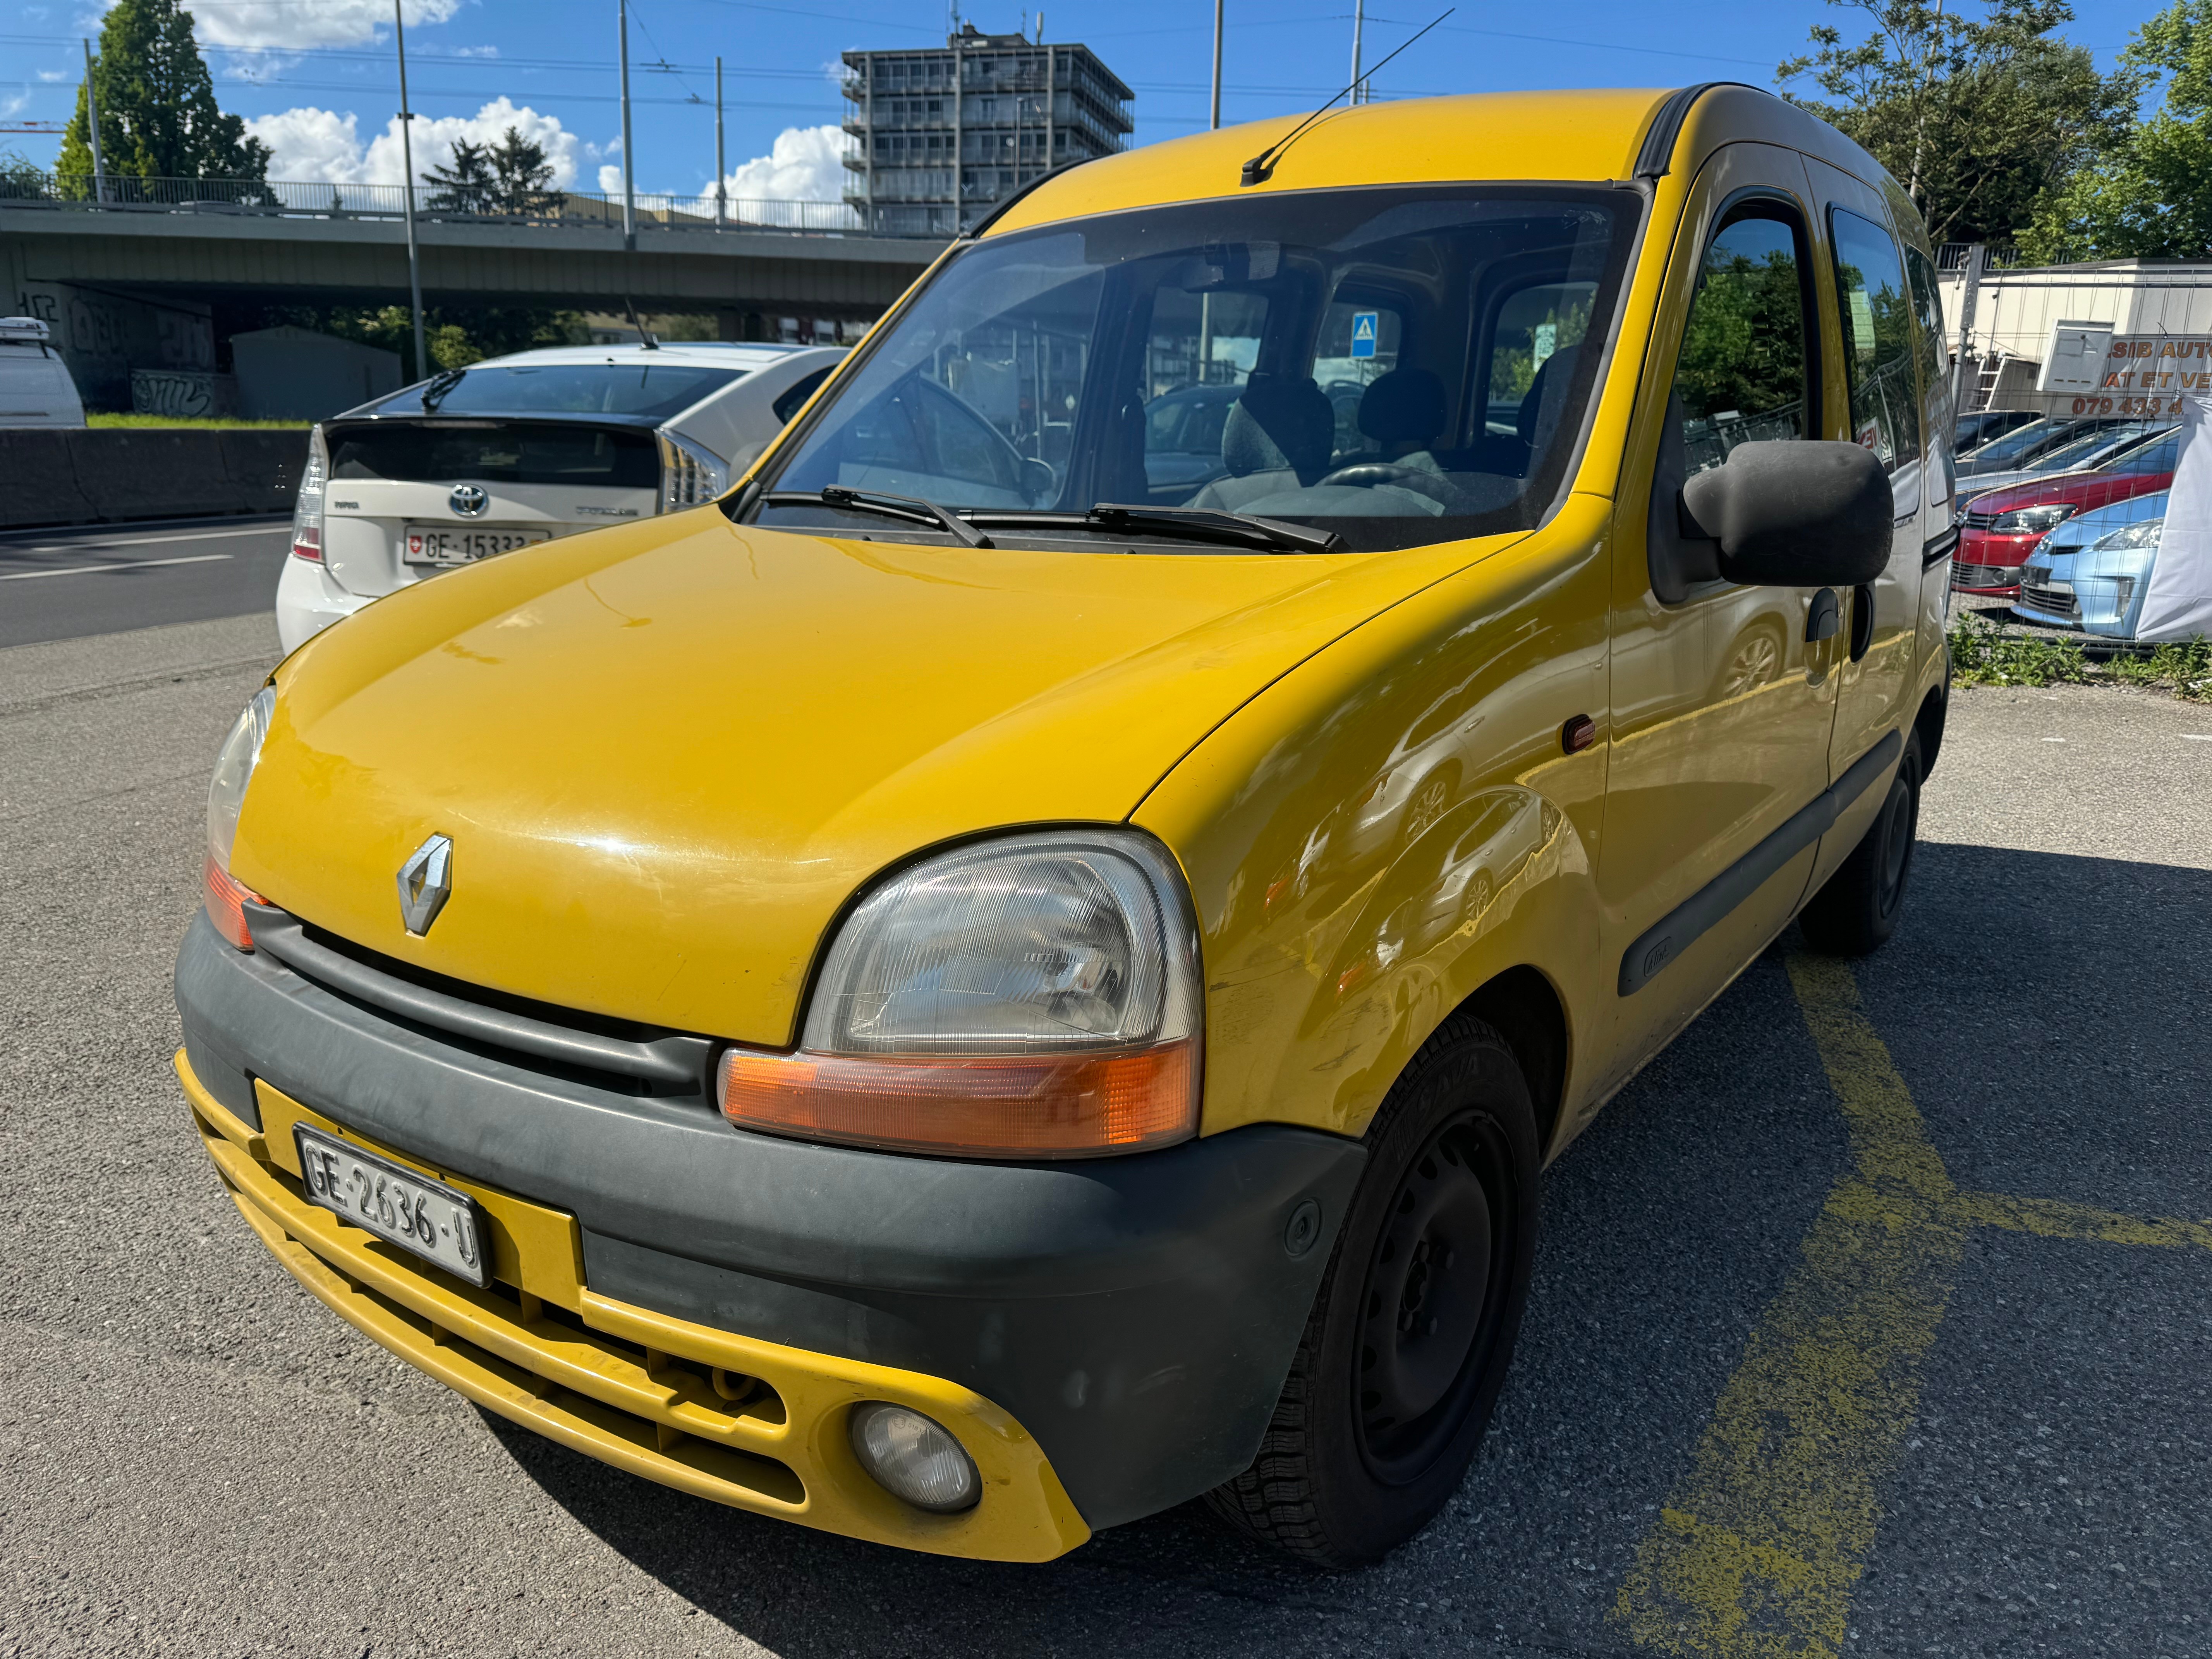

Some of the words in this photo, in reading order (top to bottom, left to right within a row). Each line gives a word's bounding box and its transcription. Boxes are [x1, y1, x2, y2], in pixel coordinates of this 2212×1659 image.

[2160, 342, 2212, 358] AUT
[2100, 371, 2136, 388] AT
[2141, 371, 2173, 388] ET
[2180, 372, 2212, 388] VE
[2072, 397, 2113, 414] 079
[2118, 397, 2161, 415] 433
[2168, 398, 2184, 415] 4
